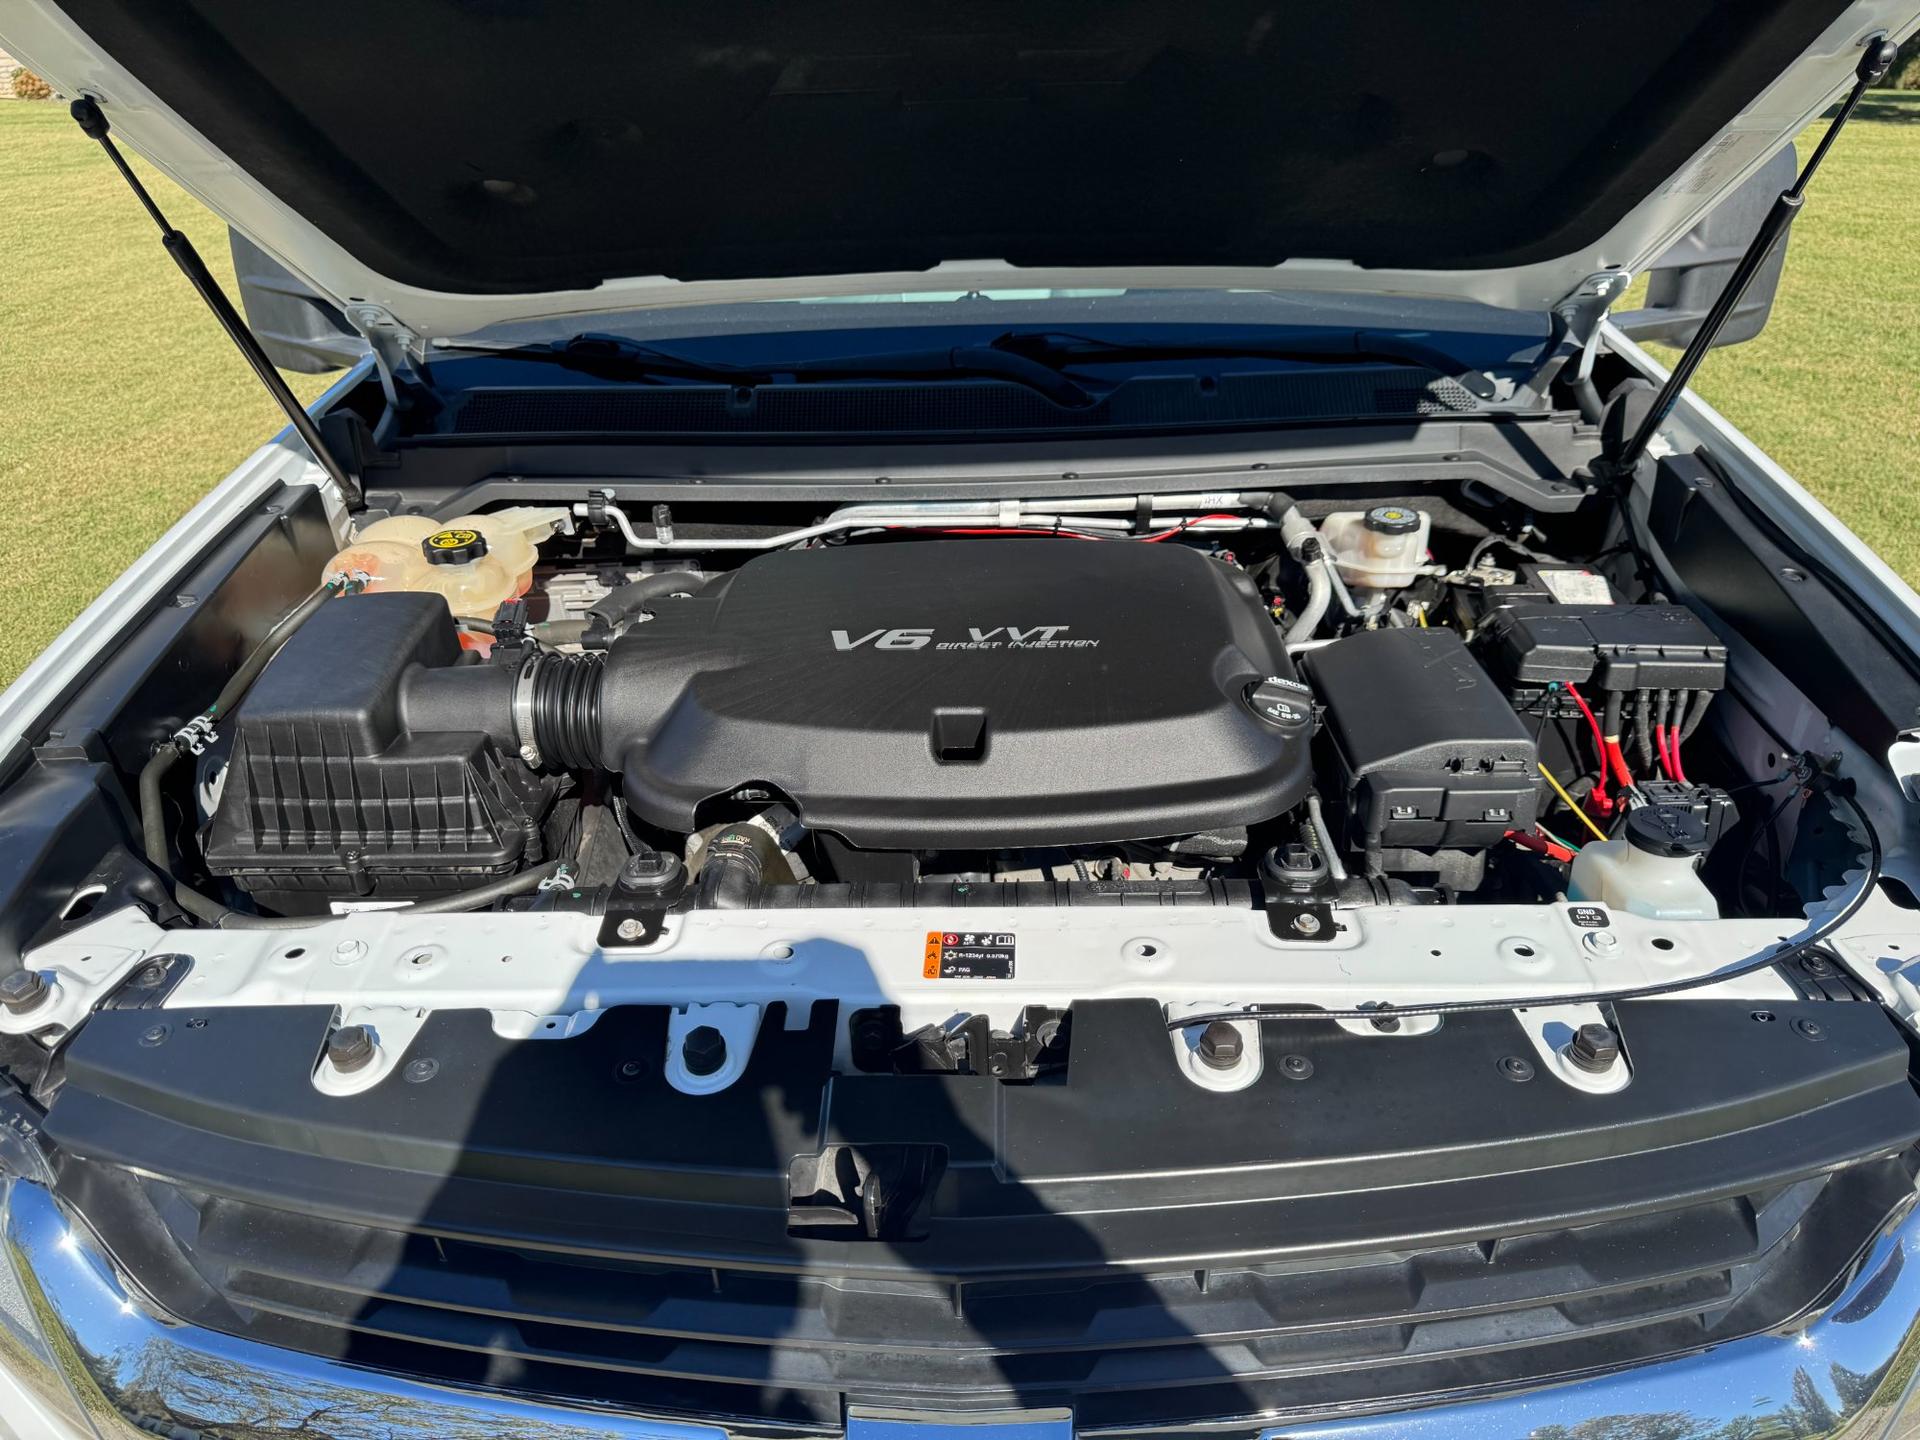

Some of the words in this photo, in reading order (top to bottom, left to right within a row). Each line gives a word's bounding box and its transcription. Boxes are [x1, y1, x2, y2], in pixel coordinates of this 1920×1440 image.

[831, 628, 936, 651] V6
[968, 625, 1070, 641] VVT
[936, 640, 1002, 651] DIRECT
[1007, 639, 1100, 649] INJECTION
[1268, 676, 1309, 690] dexos
